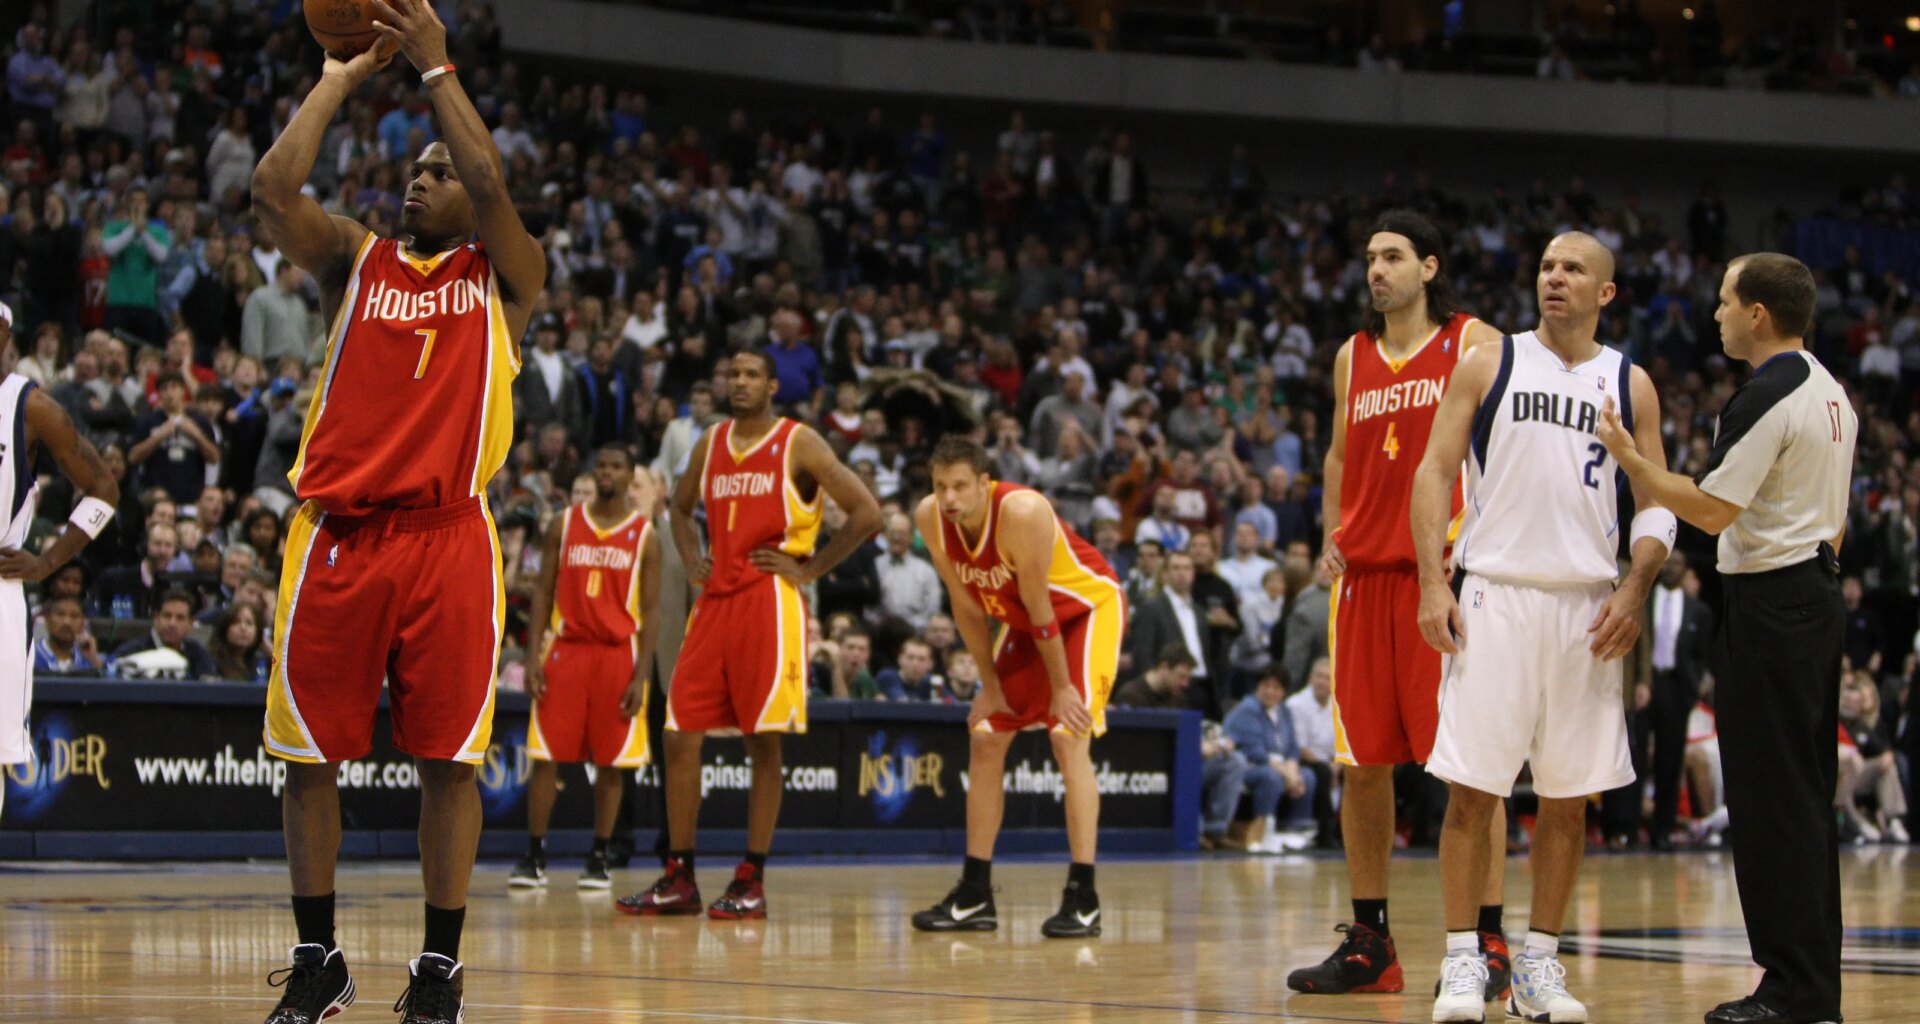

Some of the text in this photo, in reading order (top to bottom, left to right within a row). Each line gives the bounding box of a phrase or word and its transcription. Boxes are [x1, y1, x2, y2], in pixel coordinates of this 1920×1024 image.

[361, 272, 486, 322] HOUSTON
[413, 328, 438, 380] 7
[1352, 374, 1445, 425] HOUSTON
[1512, 391, 1602, 437] DALLA
[1382, 421, 1400, 460] 4
[1583, 441, 1608, 490] 2
[727, 501, 737, 532] 1
[567, 544, 634, 571] HOUSTON
[956, 561, 1013, 590] USTON
[585, 569, 602, 598] 0
[979, 592, 1007, 616] 13
